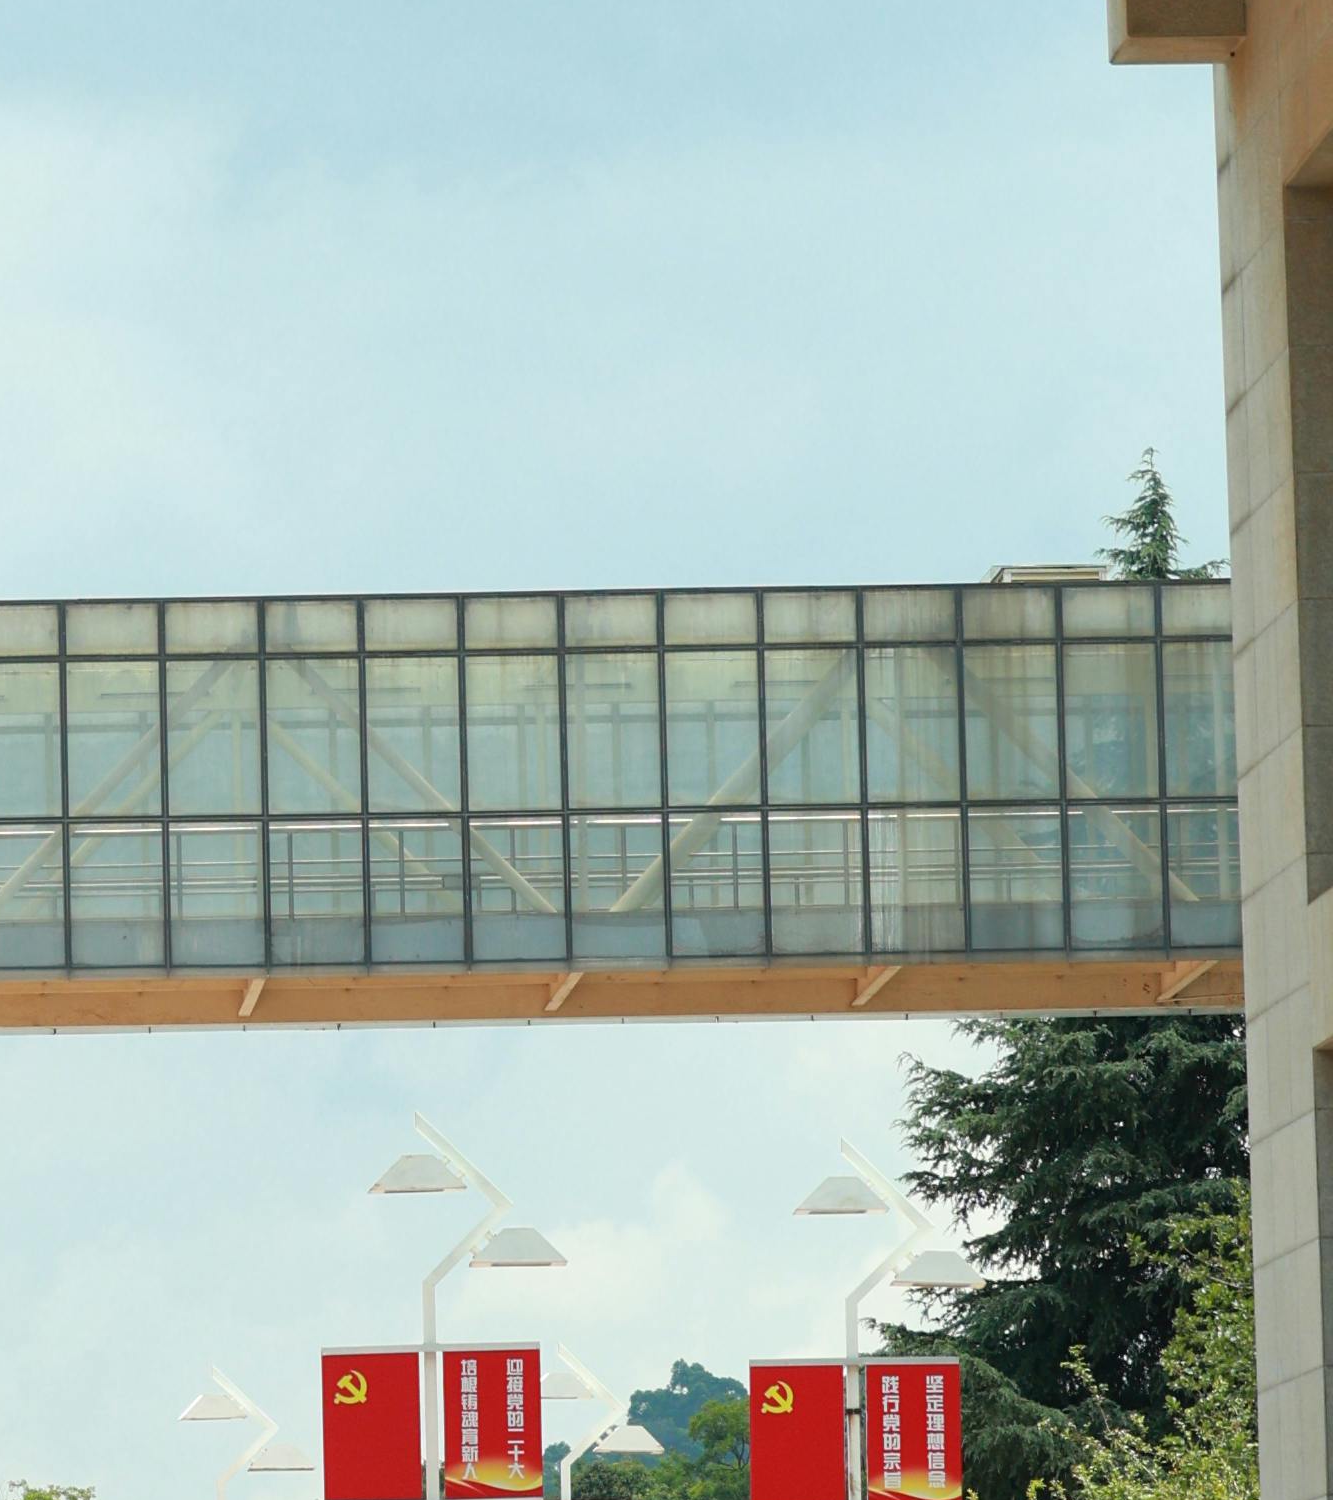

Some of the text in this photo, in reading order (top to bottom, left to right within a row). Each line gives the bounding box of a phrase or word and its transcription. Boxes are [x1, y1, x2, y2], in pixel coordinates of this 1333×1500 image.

[461, 1359, 478, 1480] 培根铸魂育新人
[507, 1358, 525, 1480] 迎接党的二十大
[881, 1375, 901, 1489] 践行党的宗旨
[926, 1375, 946, 1489] 坚定理想信念
